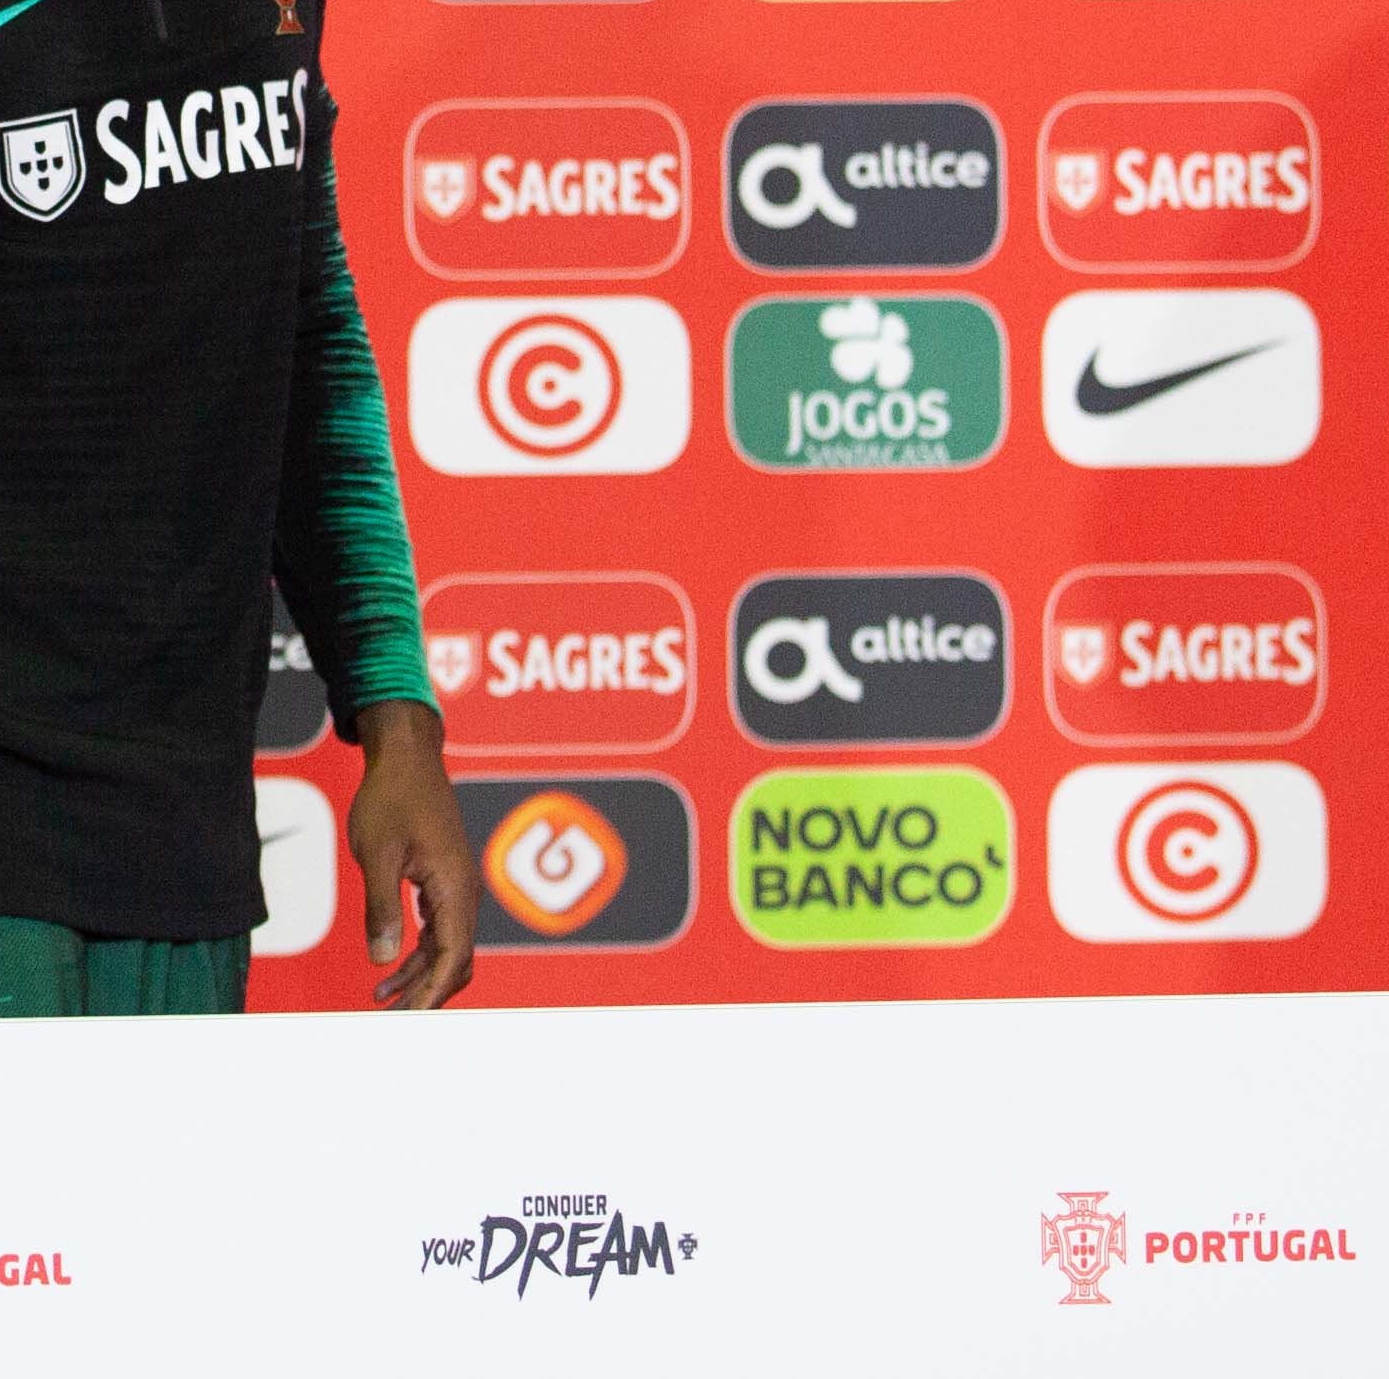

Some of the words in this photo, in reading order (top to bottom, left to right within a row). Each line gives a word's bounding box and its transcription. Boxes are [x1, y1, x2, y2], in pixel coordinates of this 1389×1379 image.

[95, 68, 309, 205] SAGRES
[845, 142, 990, 189] altice
[482, 153, 679, 222] SAGRES
[1114, 146, 1310, 215] SAGRES
[786, 388, 951, 456] JOGOS
[487, 626, 686, 697] SAGRES
[851, 616, 996, 663] altice
[1120, 617, 1317, 688] SAGRES
[751, 805, 939, 854] NOVO
[751, 861, 983, 910] BANCO
[522, 1194, 608, 1219] CONQUER
[1232, 1212, 1266, 1225] FPF
[421, 1237, 476, 1274] YOUR
[471, 1208, 675, 1302] DREAM
[1145, 1228, 1357, 1264] PORTUGAL
